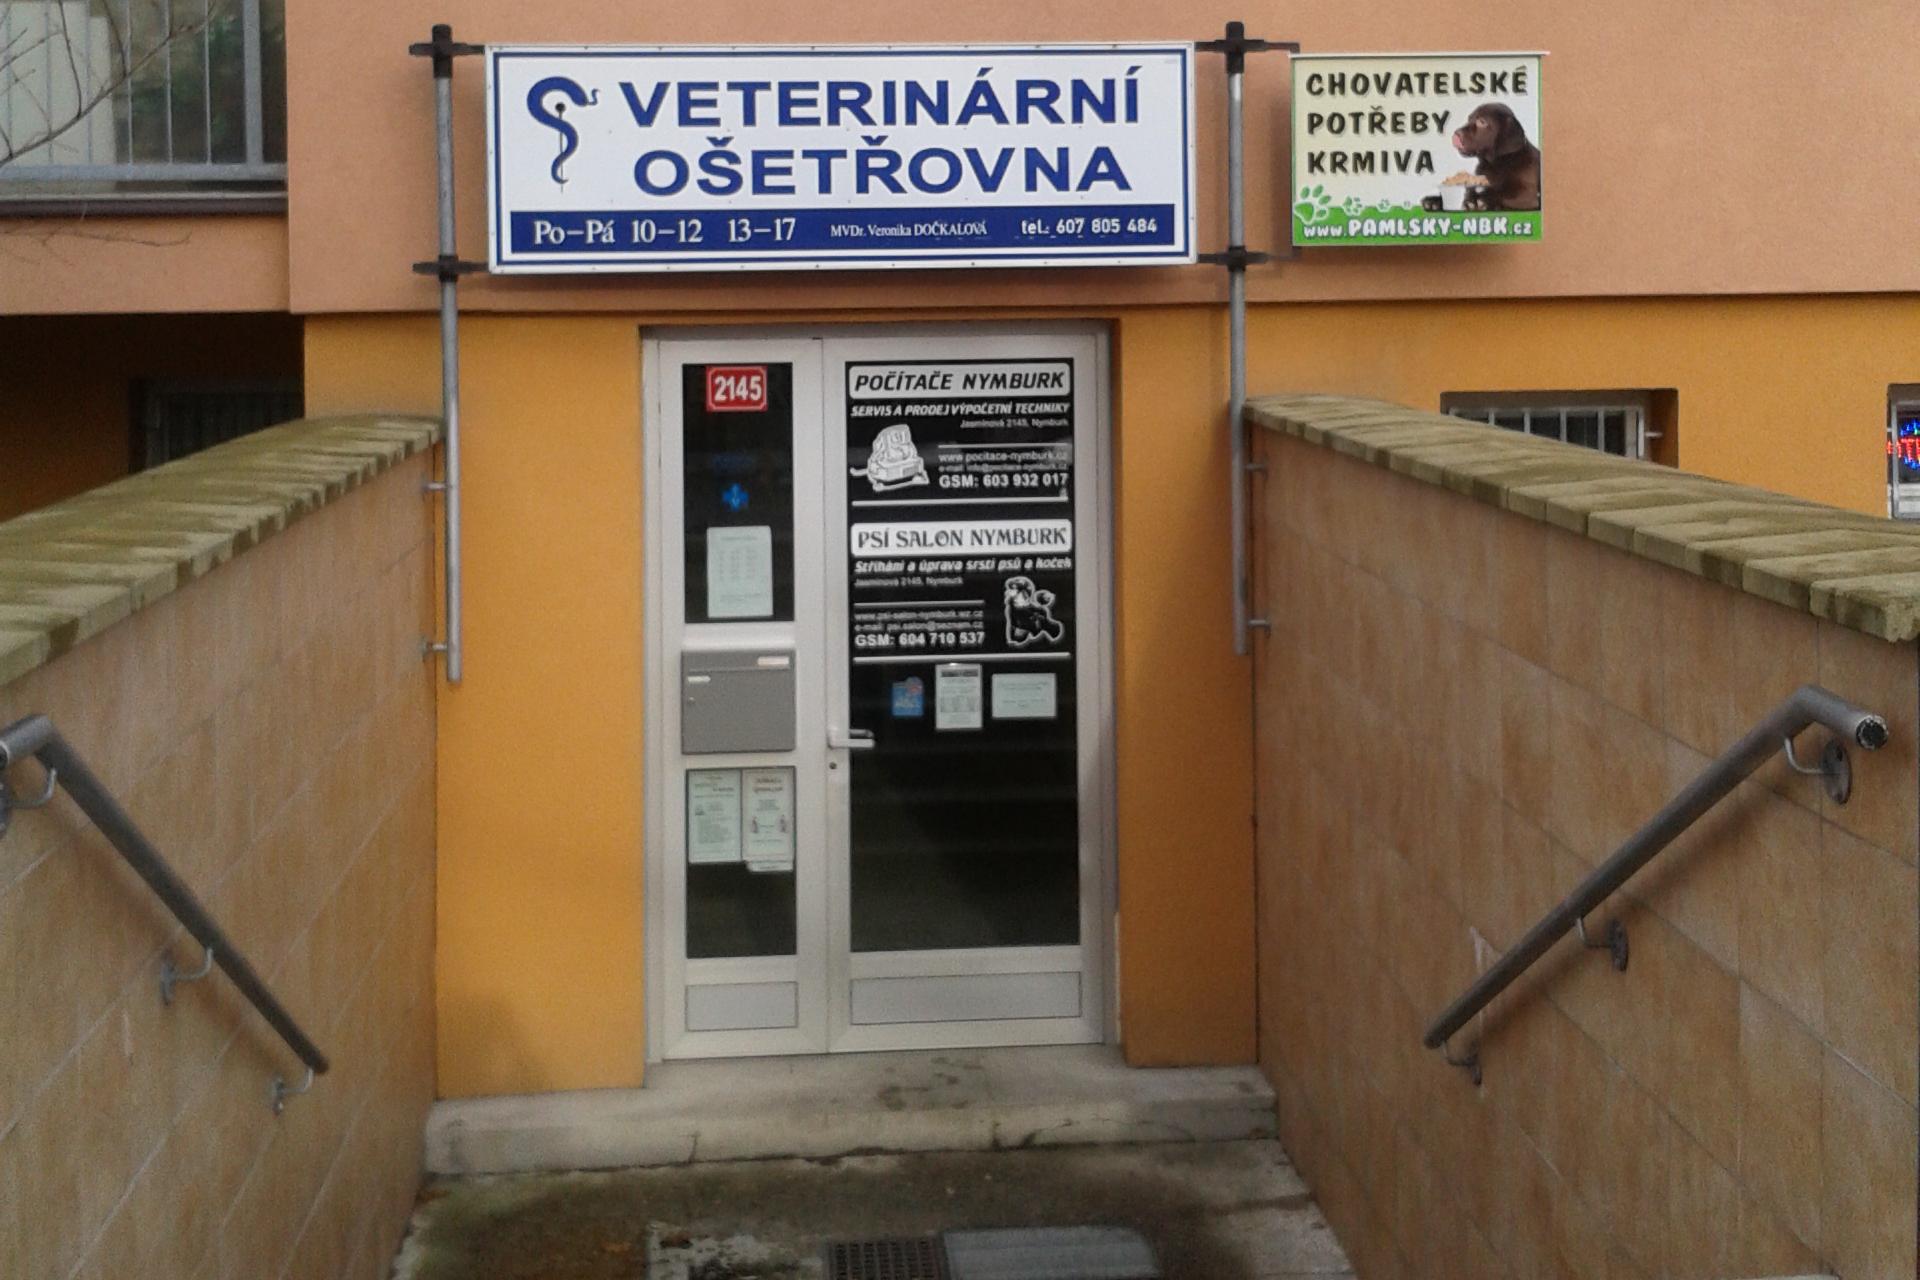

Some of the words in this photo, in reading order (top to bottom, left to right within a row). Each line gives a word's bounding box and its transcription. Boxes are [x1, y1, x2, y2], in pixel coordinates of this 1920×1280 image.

[1305, 65, 1529, 96] CHOVATELSKÉ
[617, 65, 1144, 128] VETERINÁRNÍ
[1306, 105, 1450, 136] POTŘEBY
[633, 135, 1131, 197] OŠETŘOVNA
[1306, 150, 1435, 175] KRMIVA
[830, 224, 866, 238] MVDr.
[868, 223, 912, 237] Veronika
[914, 220, 988, 237] DOČKALOVÁ
[1056, 218, 1085, 234] 607
[1091, 218, 1121, 233] 805
[1127, 217, 1158, 233] 484
[714, 376, 762, 401] 2145
[854, 370, 954, 392] POČÍTAČE
[962, 371, 1064, 390] NYMBURK
[850, 405, 892, 417] SERVIS
[893, 404, 903, 416] A
[904, 404, 950, 416] PRODEJ
[951, 401, 1013, 415] VÝPOČETNÍ
[1015, 402, 1071, 414] TECHNIKY
[939, 474, 980, 488] GSM:
[983, 474, 1009, 487] 603
[1013, 474, 1039, 487] 932
[1043, 473, 1068, 486] 017
[858, 528, 889, 548] PSÍ
[896, 530, 963, 547] SALON
[971, 527, 1066, 546] NYMBURK
[907, 562, 916, 571] a
[966, 558, 995, 570] srsti
[1024, 558, 1033, 569] a
[855, 633, 896, 647] GSM:
[899, 633, 925, 645] 604
[929, 632, 955, 645] 710
[960, 631, 985, 644] 537
